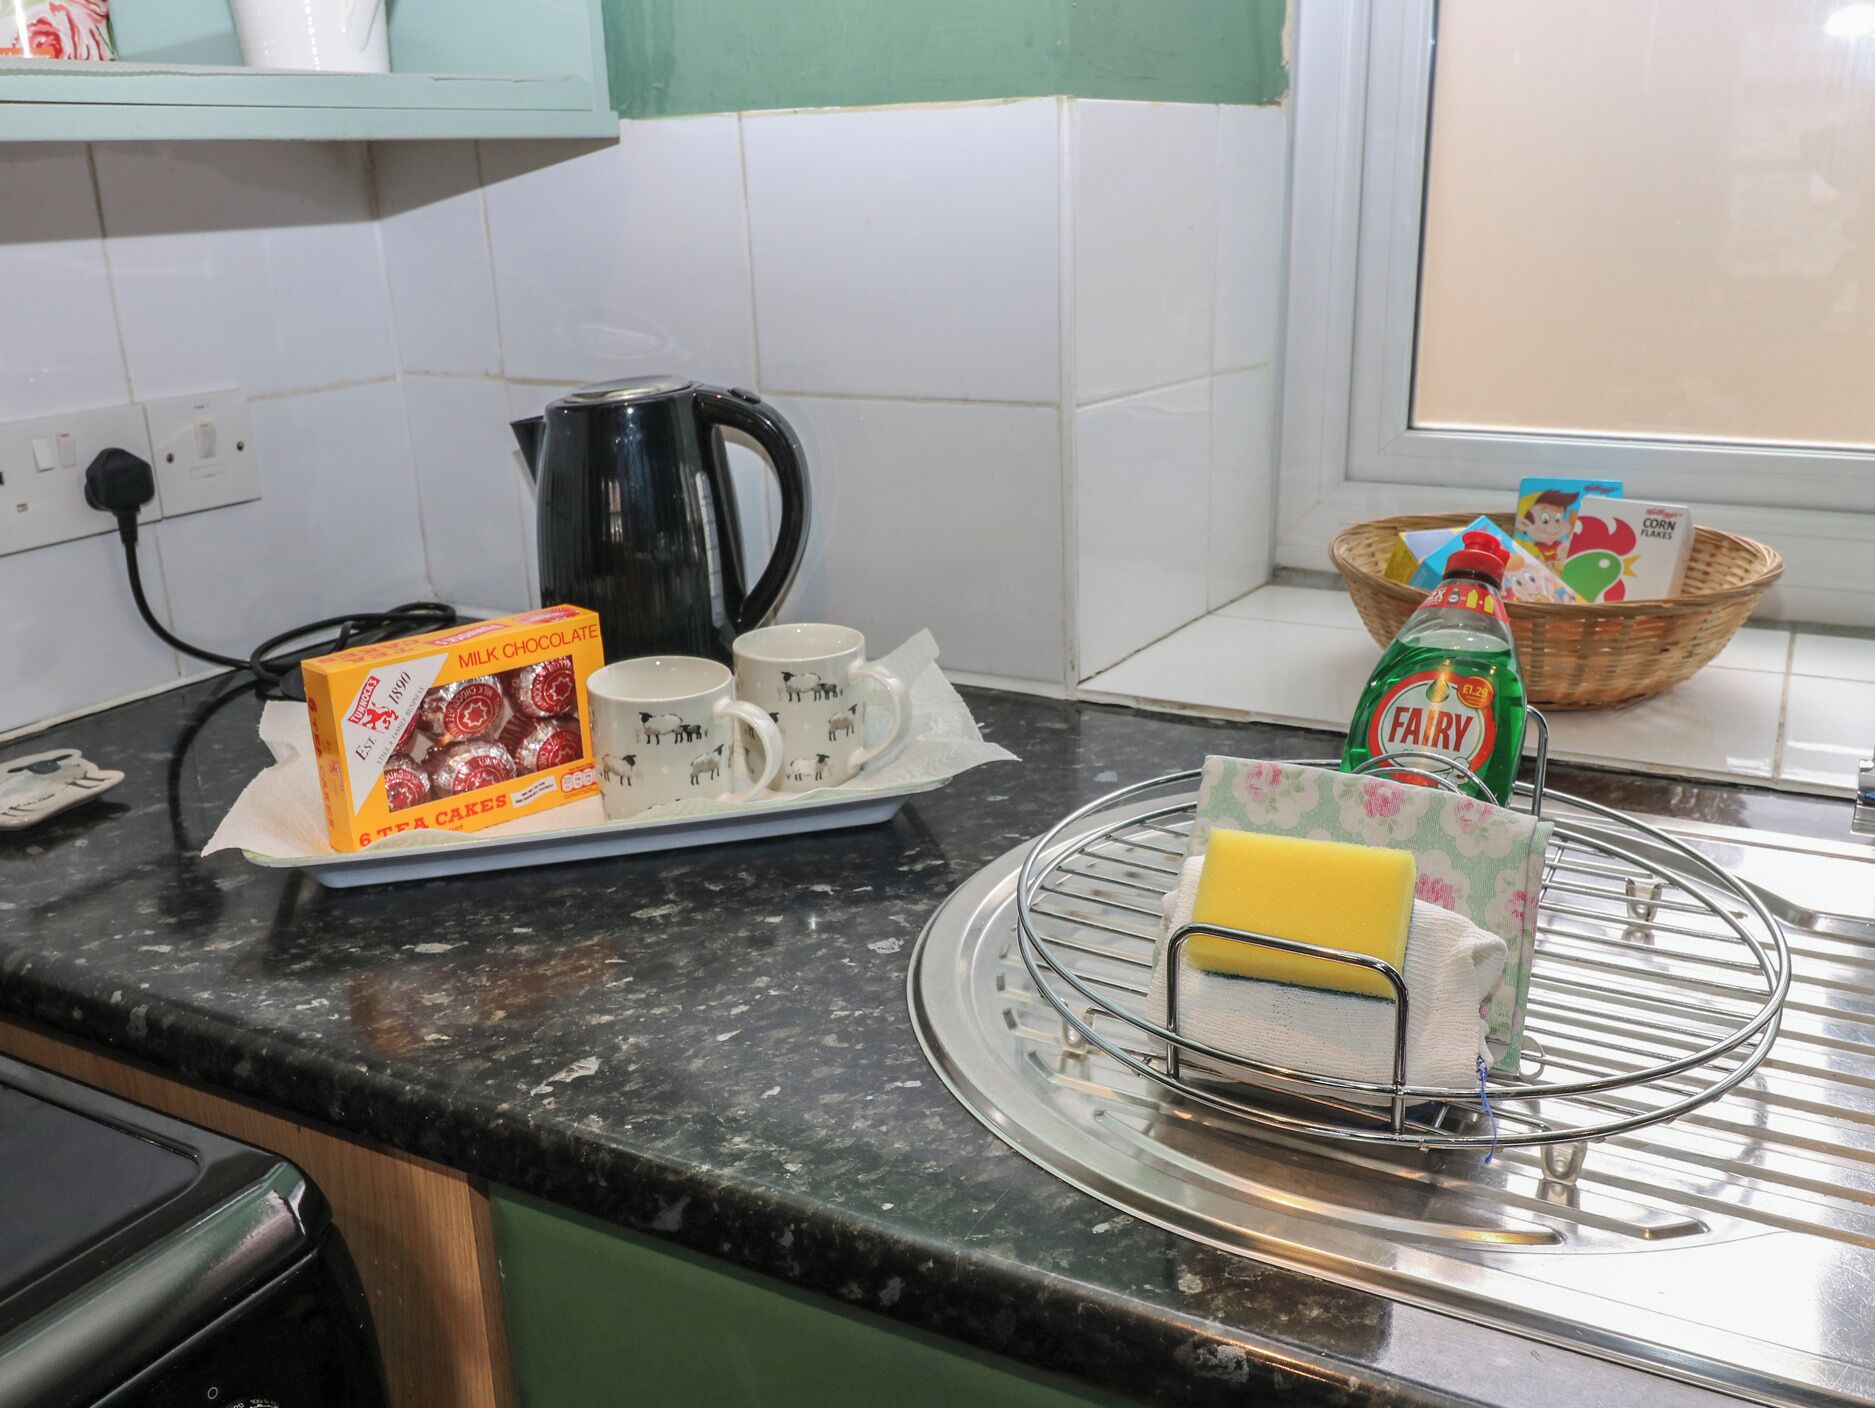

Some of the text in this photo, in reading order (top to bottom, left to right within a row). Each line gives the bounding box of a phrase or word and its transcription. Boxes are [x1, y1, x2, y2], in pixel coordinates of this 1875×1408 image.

[1640, 529, 1673, 541] FLAKES
[1643, 518, 1676, 531] CORN
[458, 623, 599, 669] MILK CHOCOLATE
[388, 671, 412, 705] 1890
[1462, 685, 1489, 698] £1.29
[393, 719, 408, 743] FAMILY
[1388, 706, 1474, 752] FAIRY
[359, 832, 372, 847] 6
[376, 816, 430, 838] TEA
[434, 794, 507, 826] CAKES
